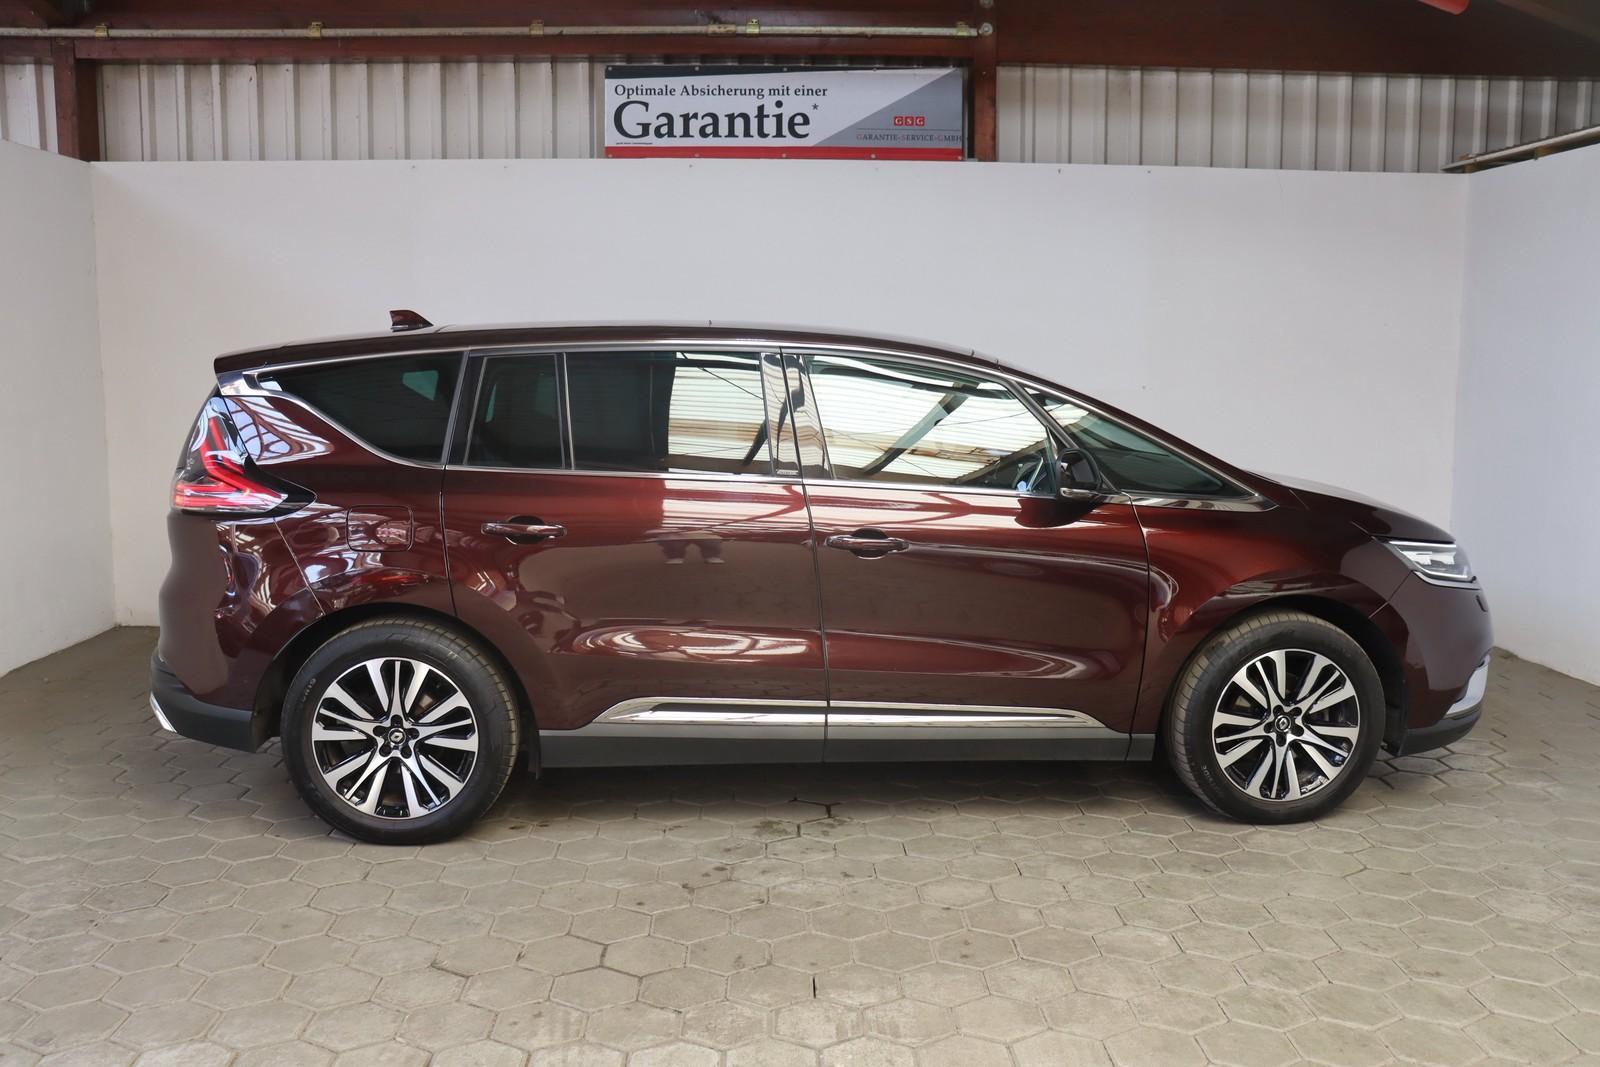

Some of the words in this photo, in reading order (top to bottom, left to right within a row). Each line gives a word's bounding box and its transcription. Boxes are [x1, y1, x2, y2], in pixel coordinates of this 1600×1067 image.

[614, 84, 676, 99] Optimale
[680, 85, 765, 99] Absicherung
[768, 86, 791, 97] mit
[794, 86, 828, 97] einer
